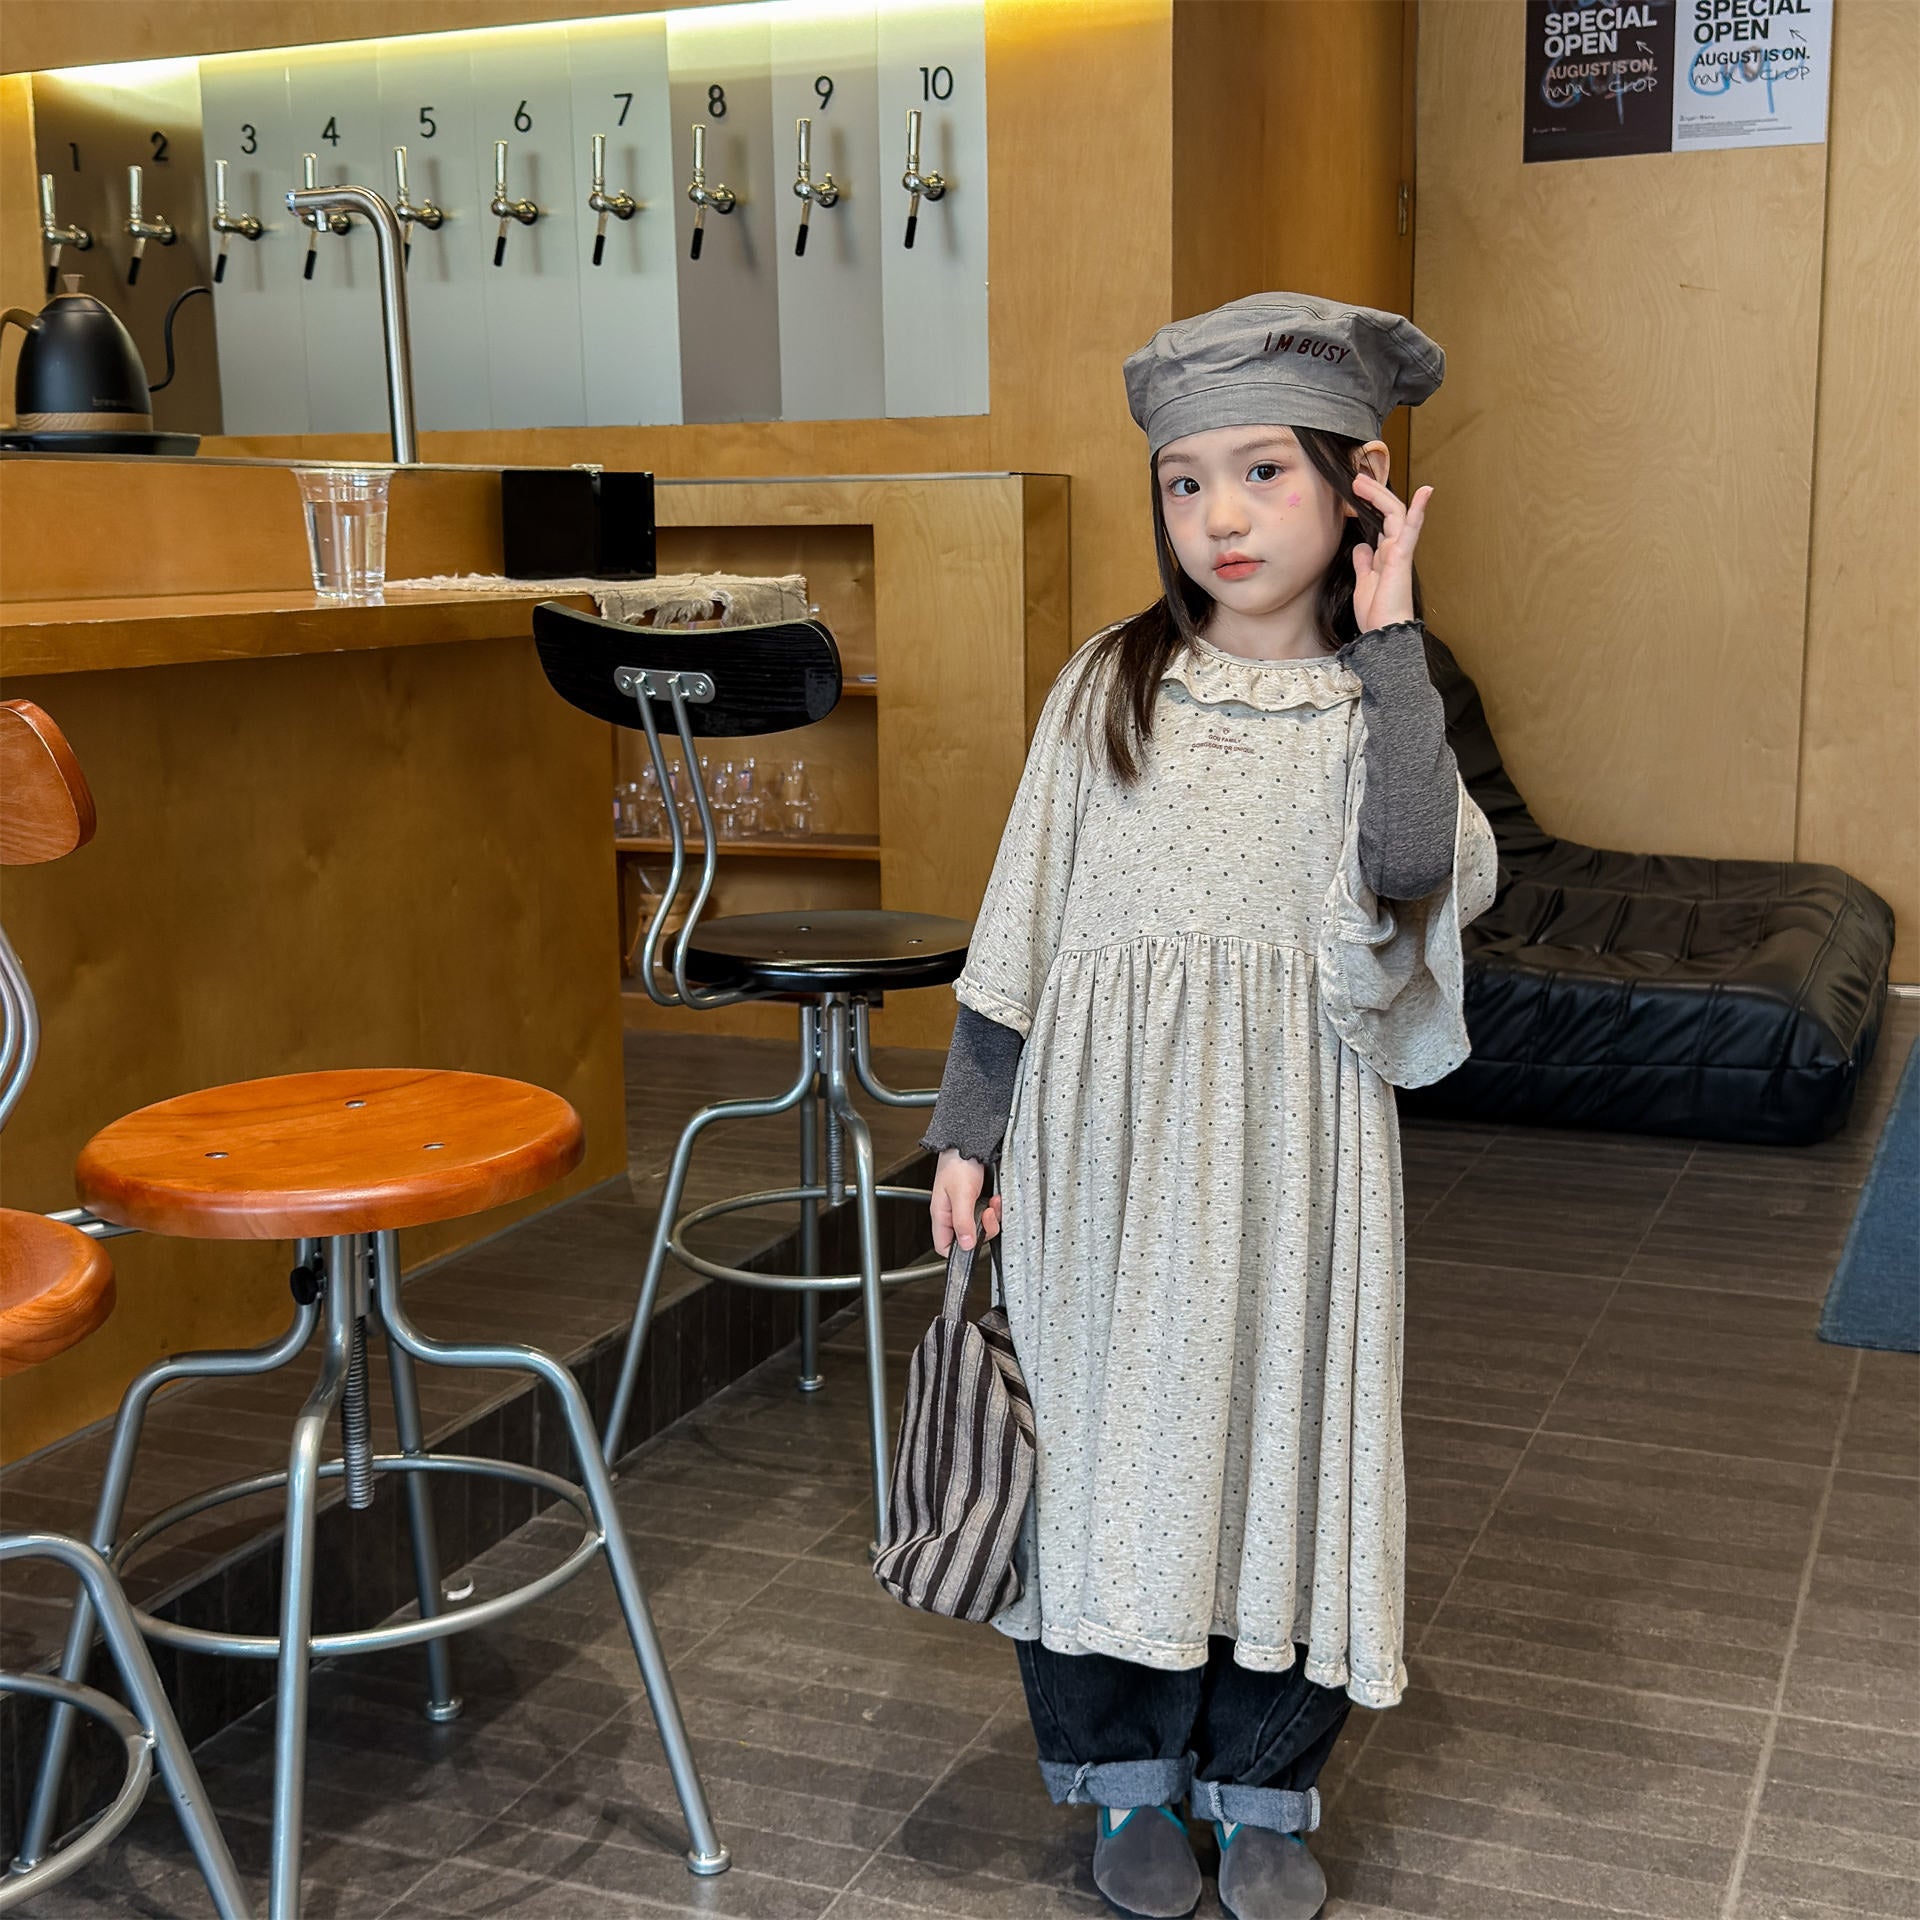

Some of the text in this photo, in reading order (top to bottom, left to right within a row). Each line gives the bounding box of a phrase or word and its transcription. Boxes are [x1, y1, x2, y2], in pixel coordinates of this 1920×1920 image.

[1544, 5, 1657, 35] SPECIAL
[1694, 0, 1811, 20] SPECIAL
[1544, 31, 1618, 58] OPEN
[1693, 18, 1769, 44] OPEN
[1549, 61, 1610, 80] AUGUST
[1629, 58, 1658, 73] ON.
[1694, 46, 1810, 67] AUGUST IS ON.
[815, 76, 834, 110] 9
[920, 65, 954, 101] 10
[514, 100, 532, 132] 6
[613, 93, 633, 126] 7
[708, 84, 727, 118] 8
[322, 117, 341, 146] 4
[419, 107, 436, 138] 5
[151, 132, 169, 162] 2
[241, 124, 257, 154] 3
[69, 142, 80, 172] 1
[1263, 331, 1351, 364] I M BUSY
